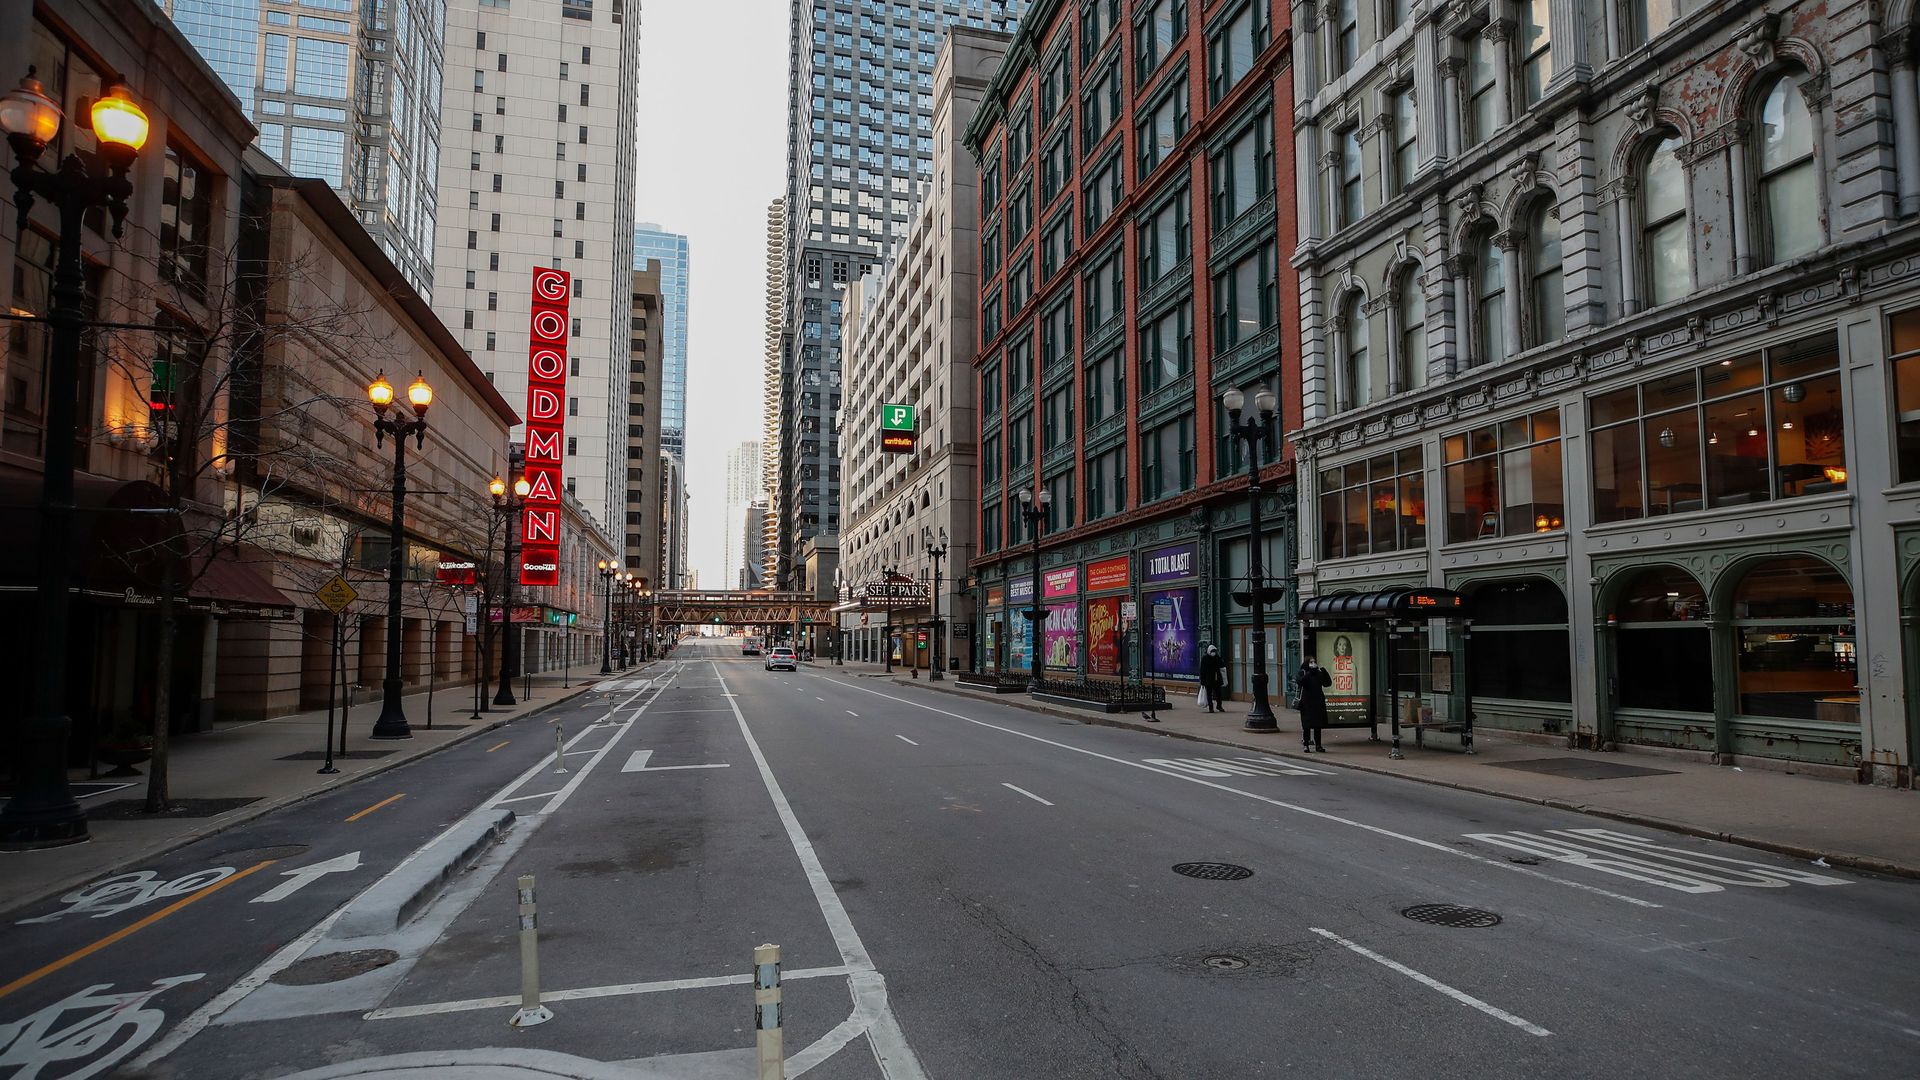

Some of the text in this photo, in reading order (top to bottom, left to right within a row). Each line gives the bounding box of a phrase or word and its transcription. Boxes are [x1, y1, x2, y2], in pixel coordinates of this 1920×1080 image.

[528, 271, 567, 541] GOODMAN
[1155, 556, 1170, 574] TOTAL
[898, 585, 926, 597] PARK
[1333, 674, 1353, 690] 100
[1462, 829, 1857, 894] BUS
